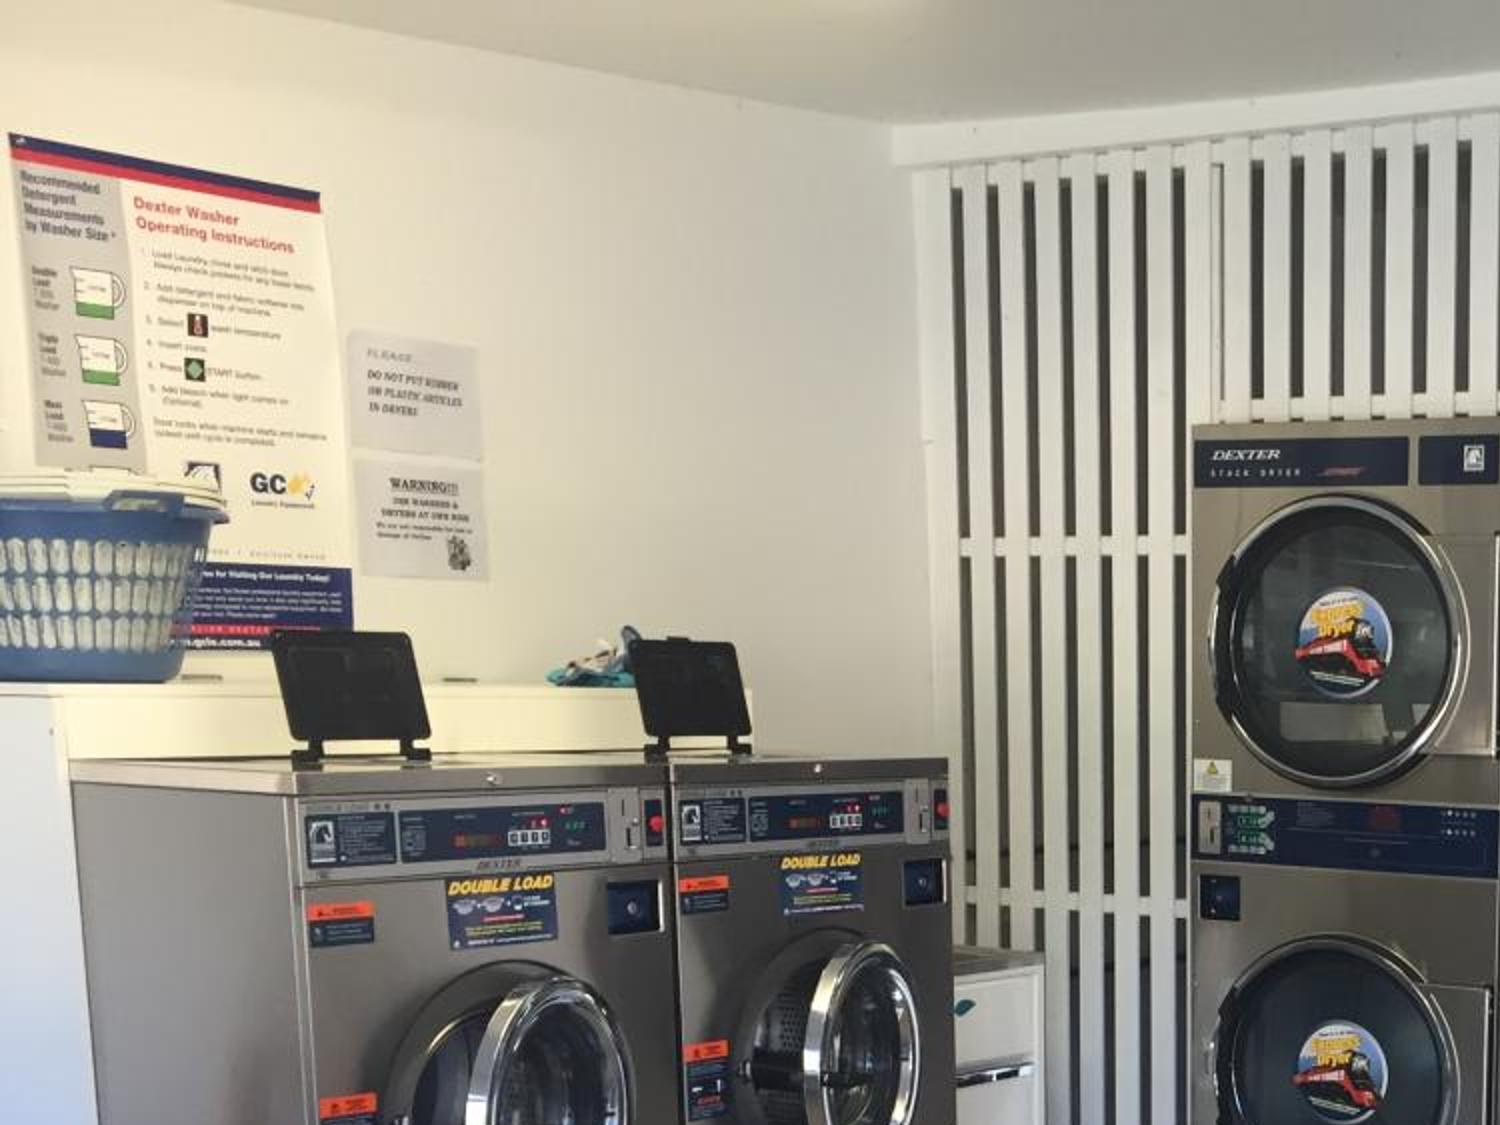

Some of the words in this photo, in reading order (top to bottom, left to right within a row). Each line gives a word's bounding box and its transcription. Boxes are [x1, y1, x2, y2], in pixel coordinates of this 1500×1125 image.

[133, 196, 182, 215] Dexter
[186, 205, 239, 225] Washer
[135, 216, 208, 242] Operating
[211, 228, 296, 254] Instructions
[367, 369, 382, 381] DO
[383, 371, 406, 383] NOT
[405, 375, 424, 387] PUT
[1211, 448, 1282, 461] DEXTER
[780, 854, 830, 871] DOUBLE
[829, 852, 862, 868] LOAD
[447, 878, 512, 897] DOUBLE
[512, 874, 554, 892] LOAD
